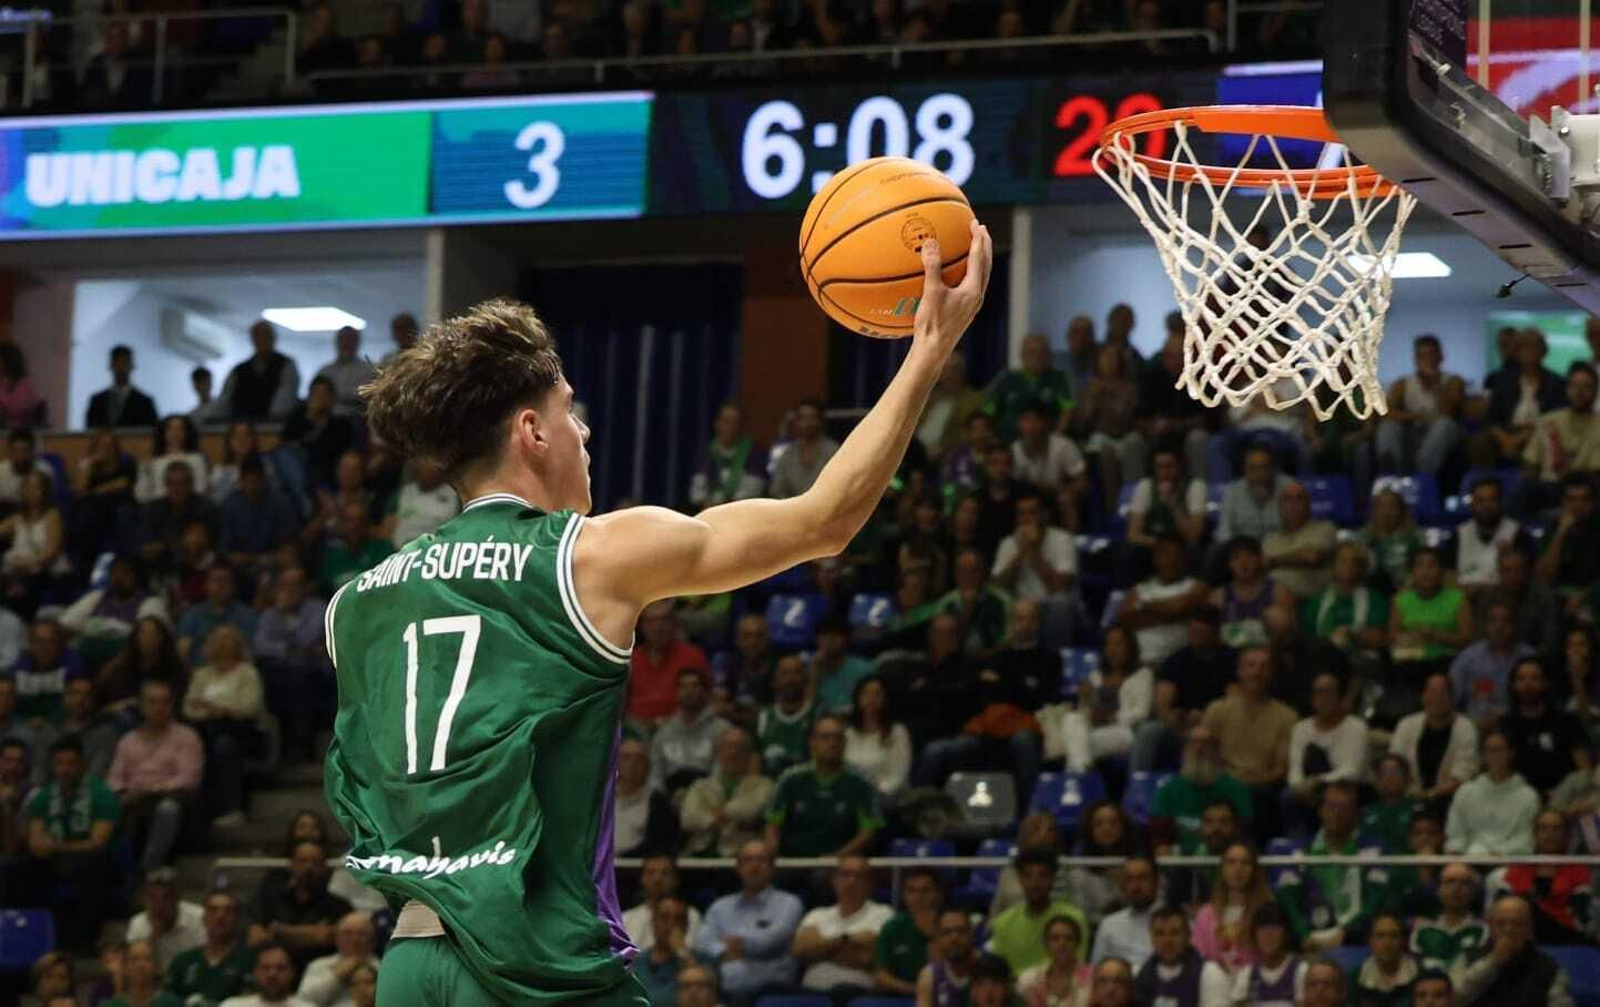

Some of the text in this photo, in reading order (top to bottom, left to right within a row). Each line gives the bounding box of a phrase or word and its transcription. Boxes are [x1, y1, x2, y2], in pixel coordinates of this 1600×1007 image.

[25, 144, 301, 207] UNICAJA
[503, 120, 565, 210] 3
[741, 93, 976, 199] 6:08
[1053, 92, 1167, 178] 20
[356, 535, 534, 592] SAINT-SUPÉRY
[402, 614, 482, 775] 17
